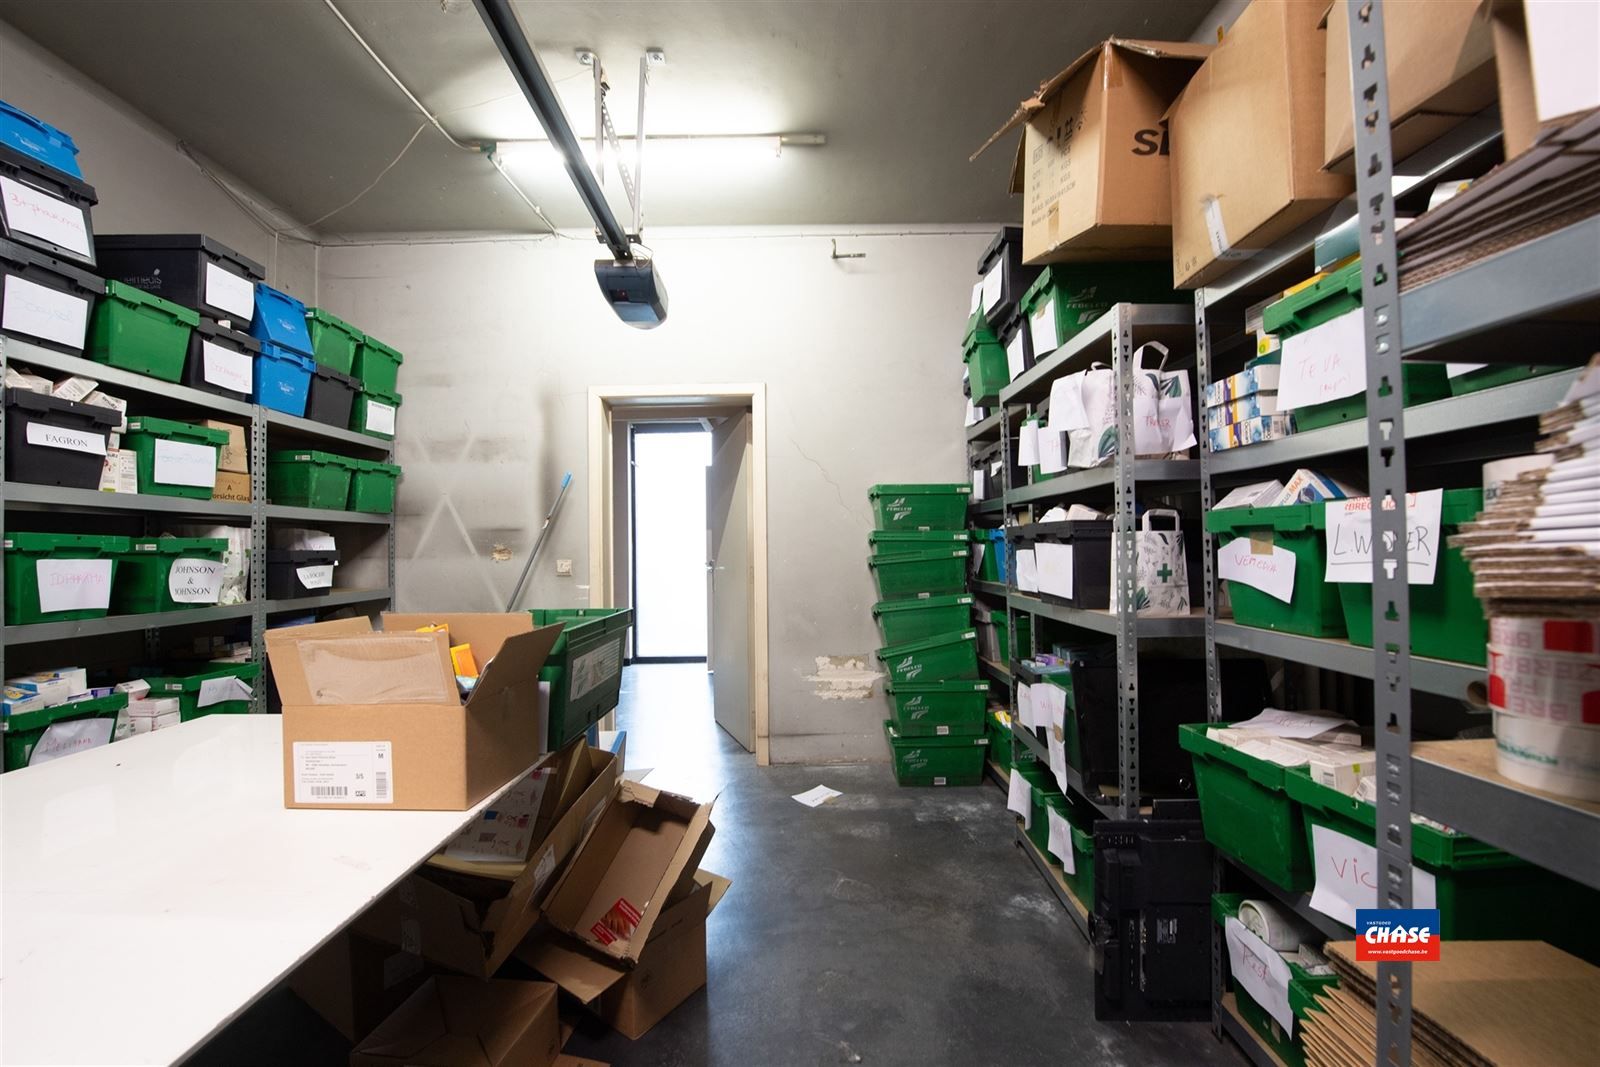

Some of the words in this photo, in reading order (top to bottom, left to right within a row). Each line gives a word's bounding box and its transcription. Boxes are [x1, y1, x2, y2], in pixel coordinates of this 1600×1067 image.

[45, 433, 88, 448] FAGRON
[1289, 476, 1303, 494] MAX
[212, 492, 235, 501] orsicht
[174, 565, 216, 575] JOHNSON
[174, 587, 211, 596] JOHNSON
